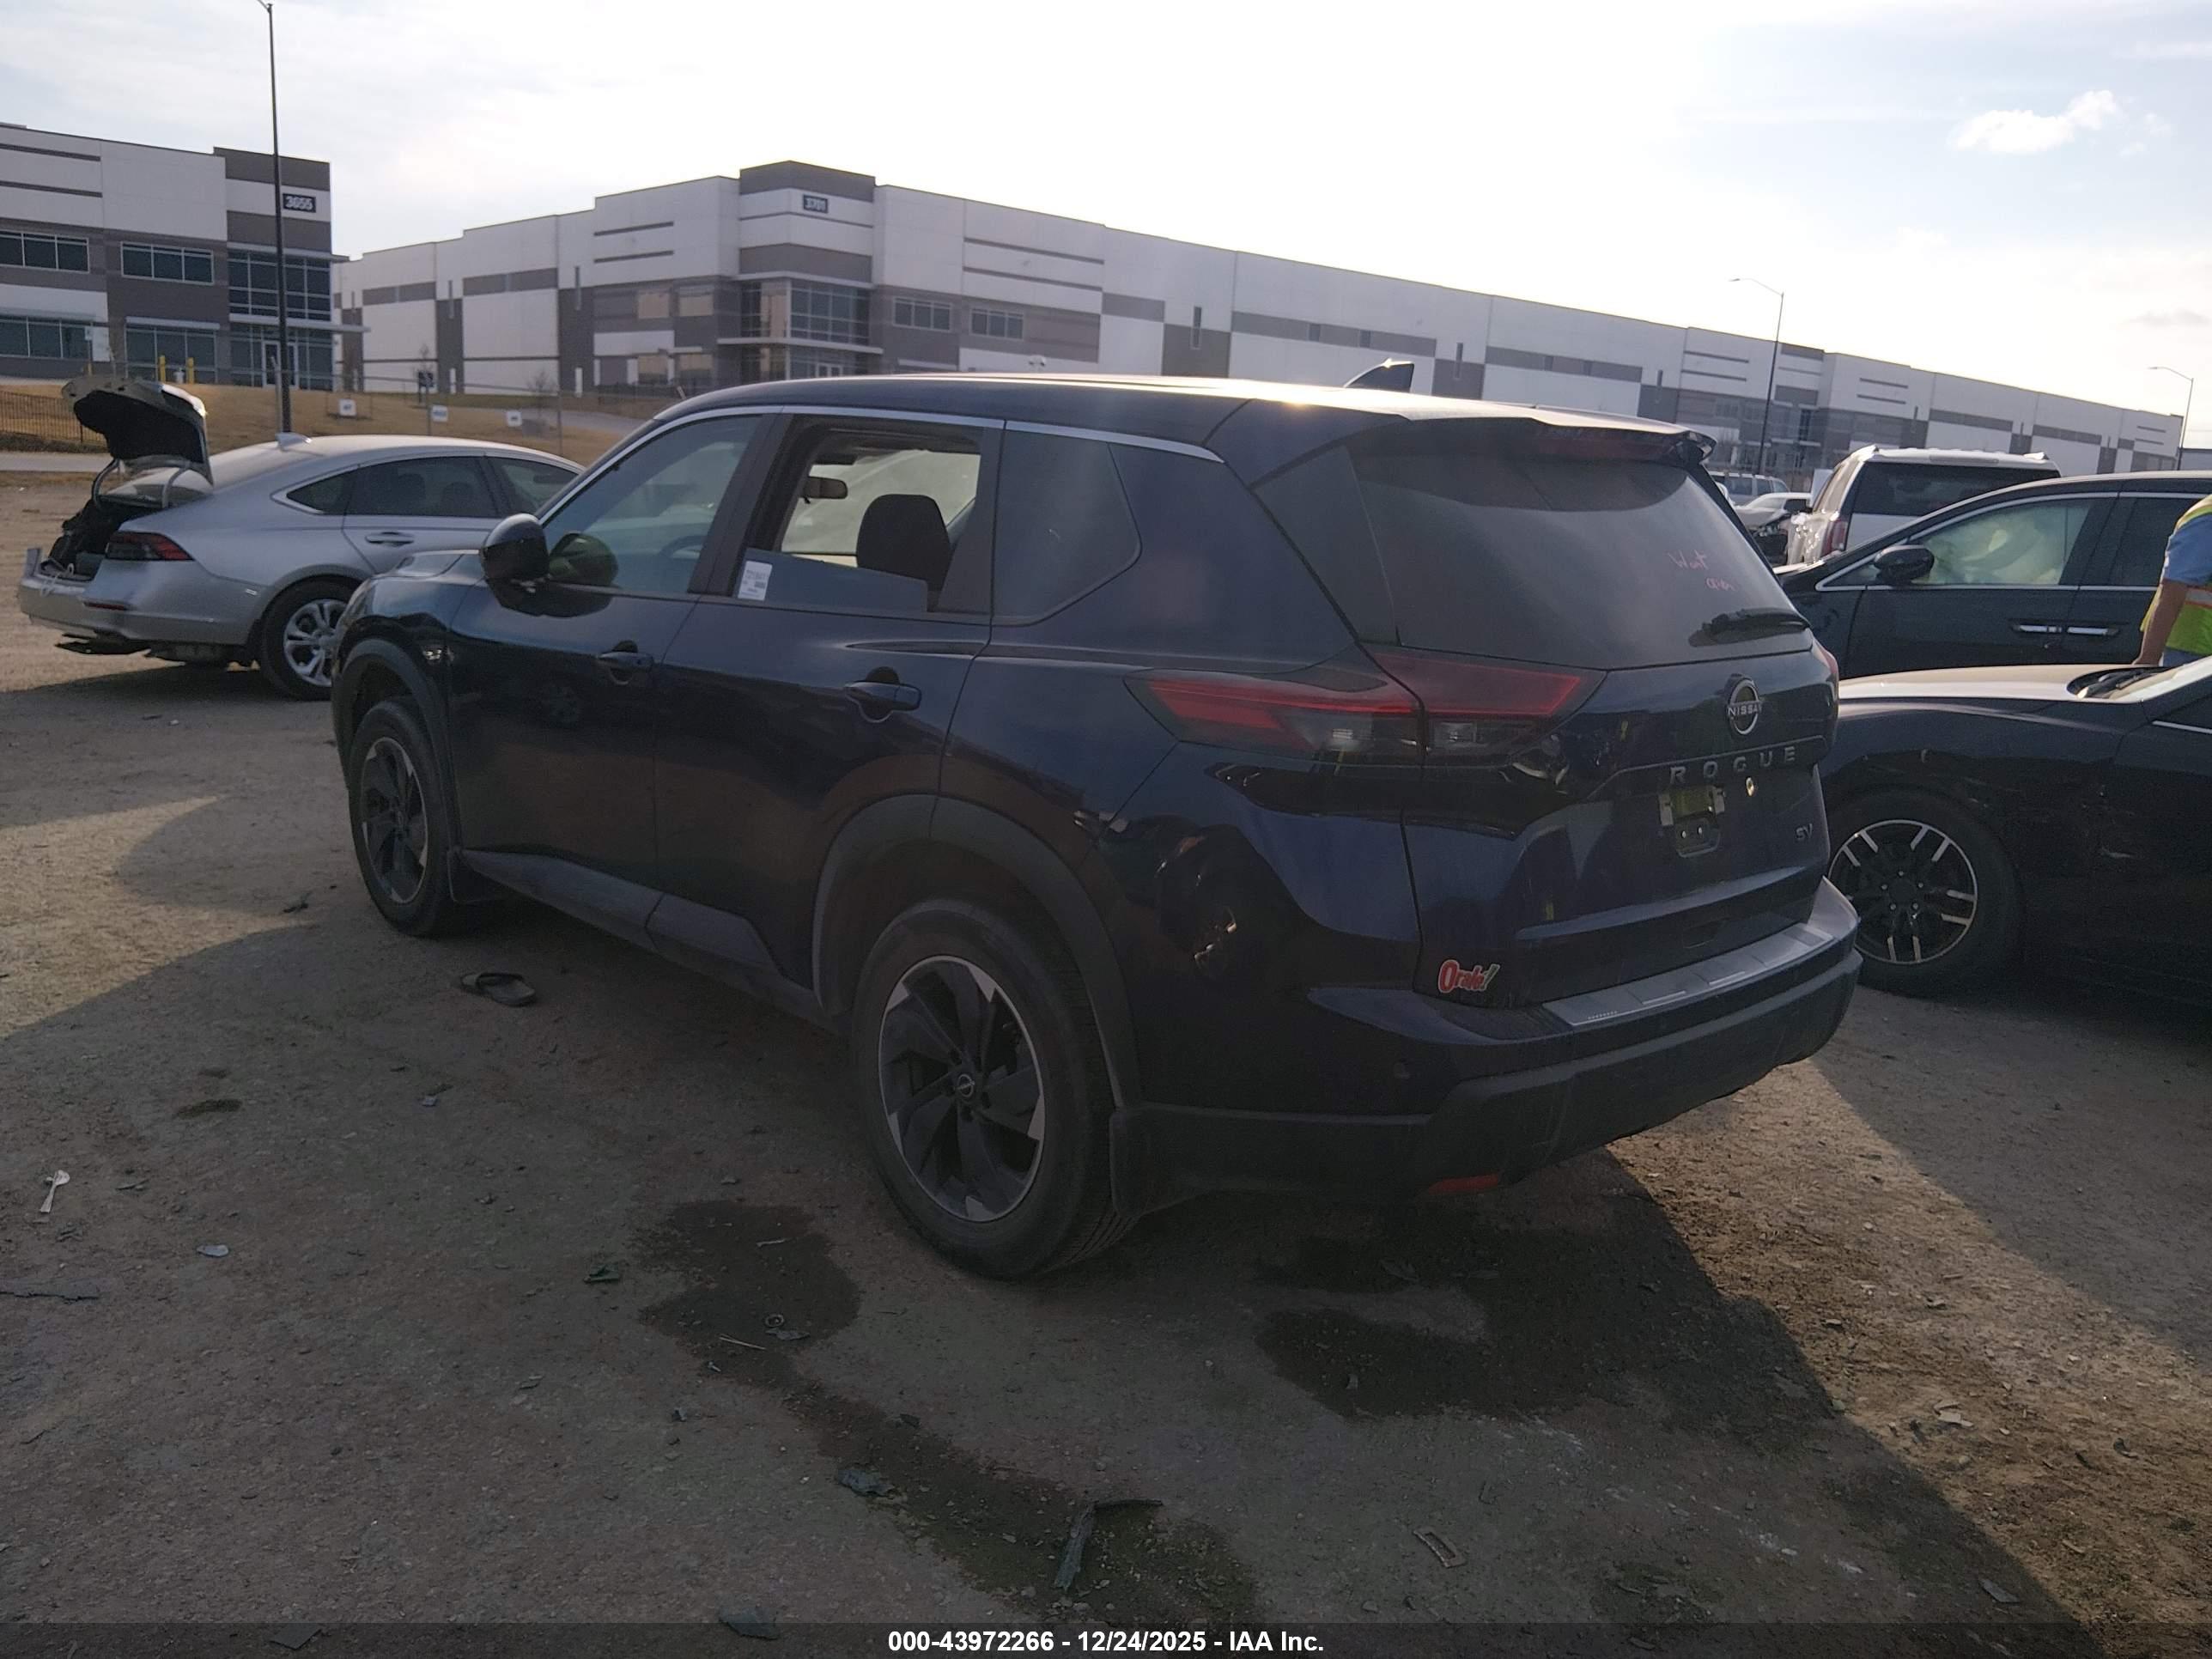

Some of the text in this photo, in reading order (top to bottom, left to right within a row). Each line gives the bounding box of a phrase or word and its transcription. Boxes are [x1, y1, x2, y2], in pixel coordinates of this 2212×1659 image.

[1728, 702, 1763, 716] NISSAN
[1669, 745, 1796, 784] ROGUE
[1794, 822, 1814, 841] SV
